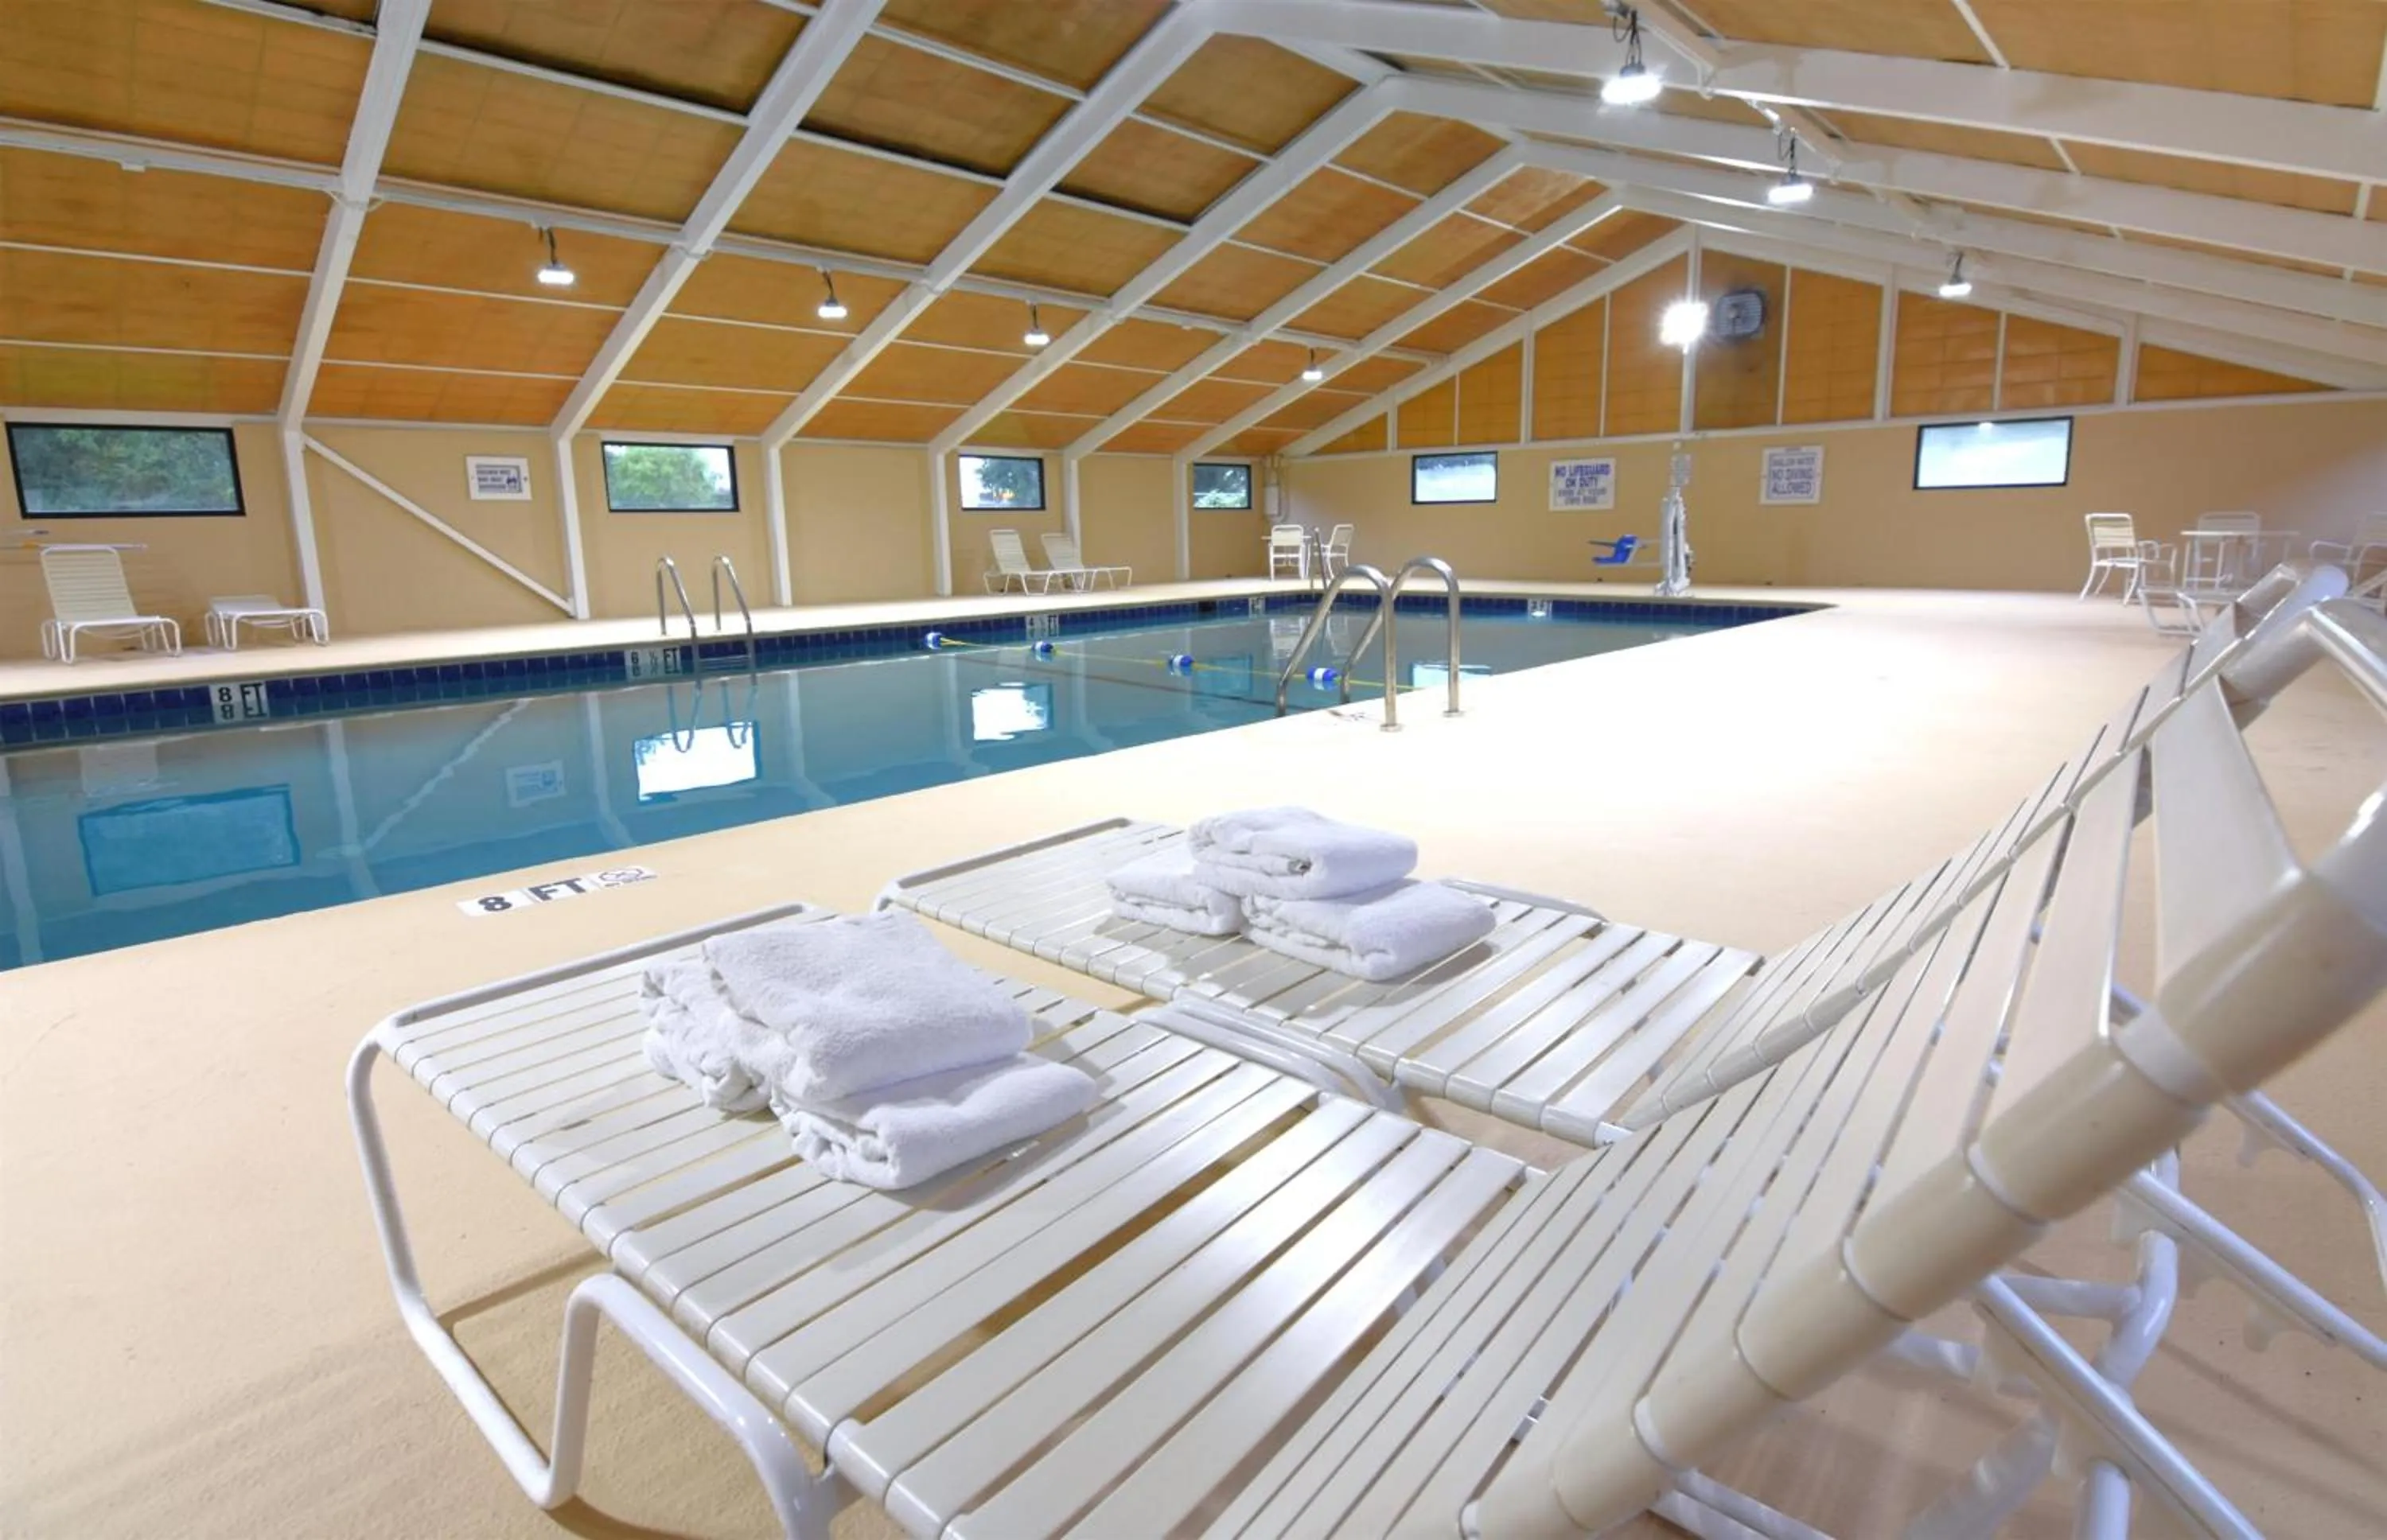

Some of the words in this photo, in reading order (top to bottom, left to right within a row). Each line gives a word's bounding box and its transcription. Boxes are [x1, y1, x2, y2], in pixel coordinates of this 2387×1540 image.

[1556, 465, 1567, 477] NO
[1569, 463, 1610, 476] LIFEGUARD
[1772, 469, 1783, 480] NO
[1785, 467, 1813, 480] DIVING
[1579, 476, 1598, 488] DUTY
[1772, 481, 1812, 495] ALLOWED
[663, 647, 678, 665] FT
[218, 686, 232, 702] 8
[239, 682, 263, 702] FT
[478, 896, 513, 912] 8
[528, 877, 587, 901] FT
